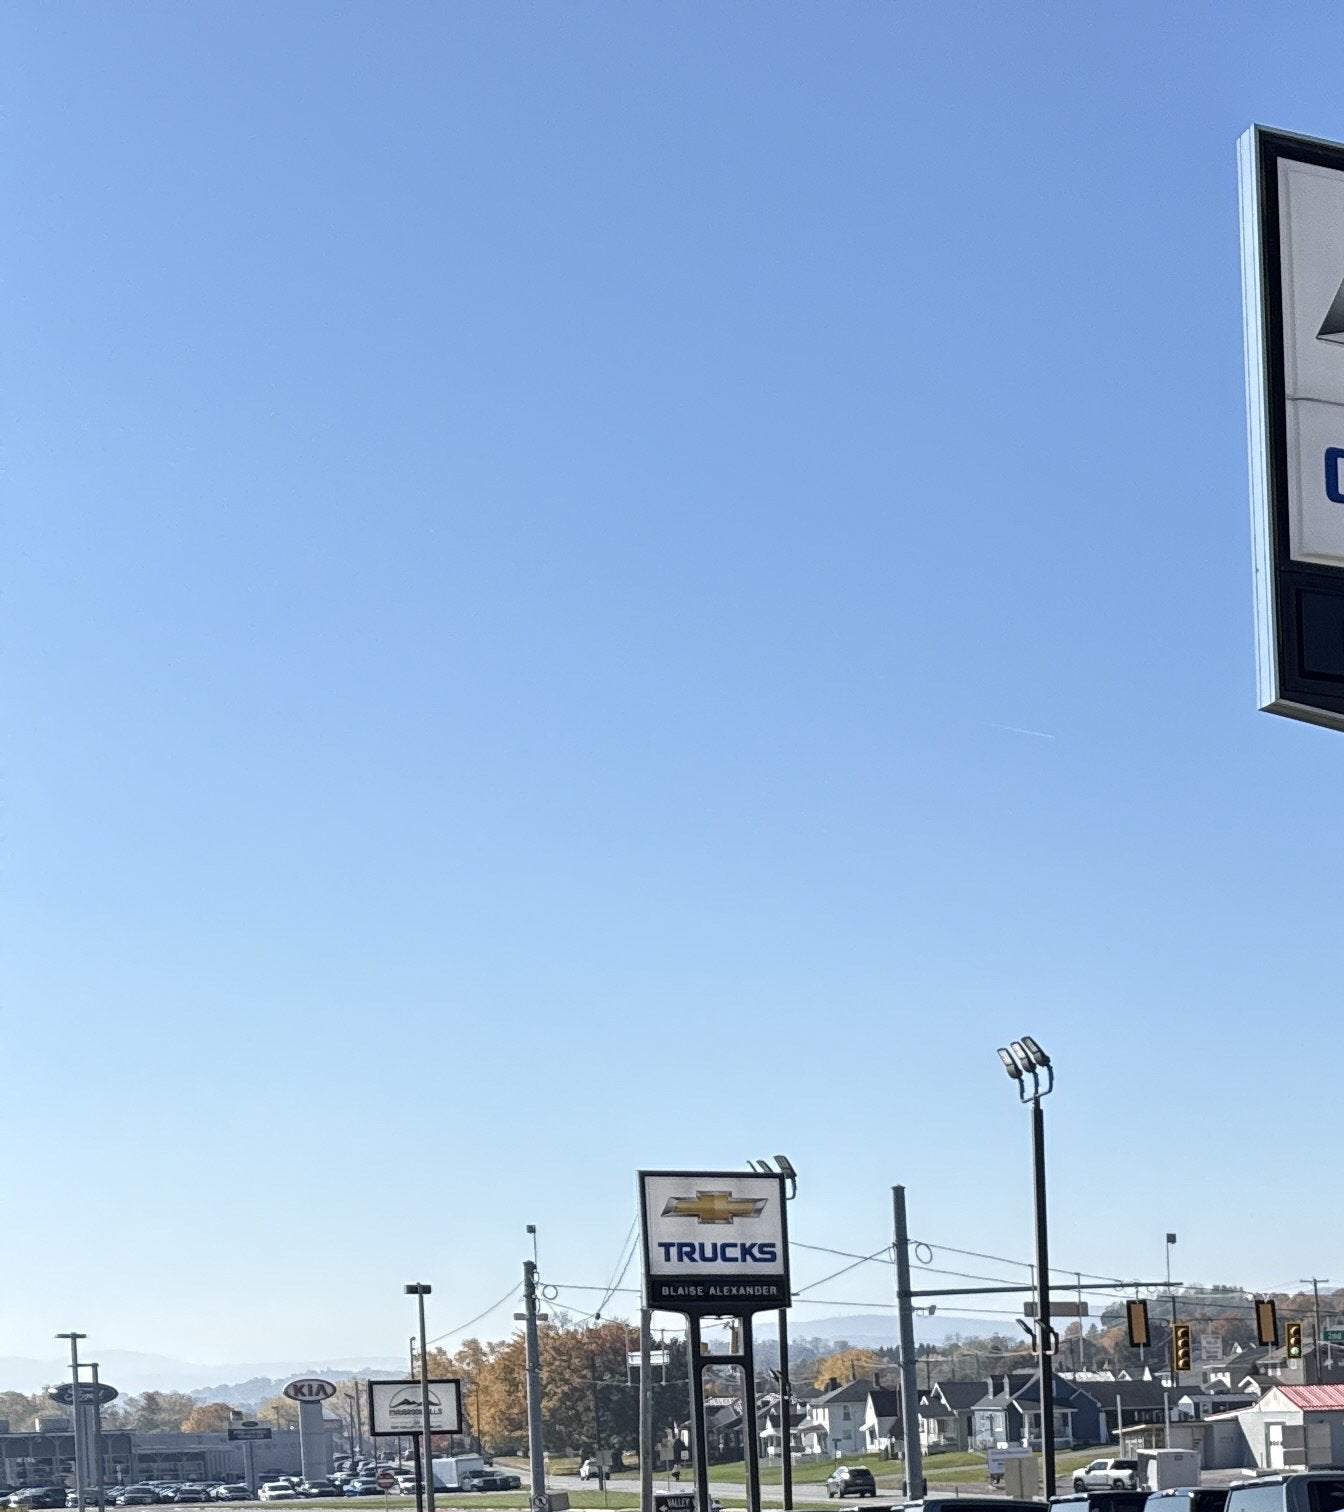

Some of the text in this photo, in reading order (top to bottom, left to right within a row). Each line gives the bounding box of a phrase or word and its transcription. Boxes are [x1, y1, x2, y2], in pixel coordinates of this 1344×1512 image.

[657, 1242, 777, 1263] TRUCKS
[661, 1285, 777, 1296] BLAISE ALEXANDER
[292, 1383, 330, 1397] KIA
